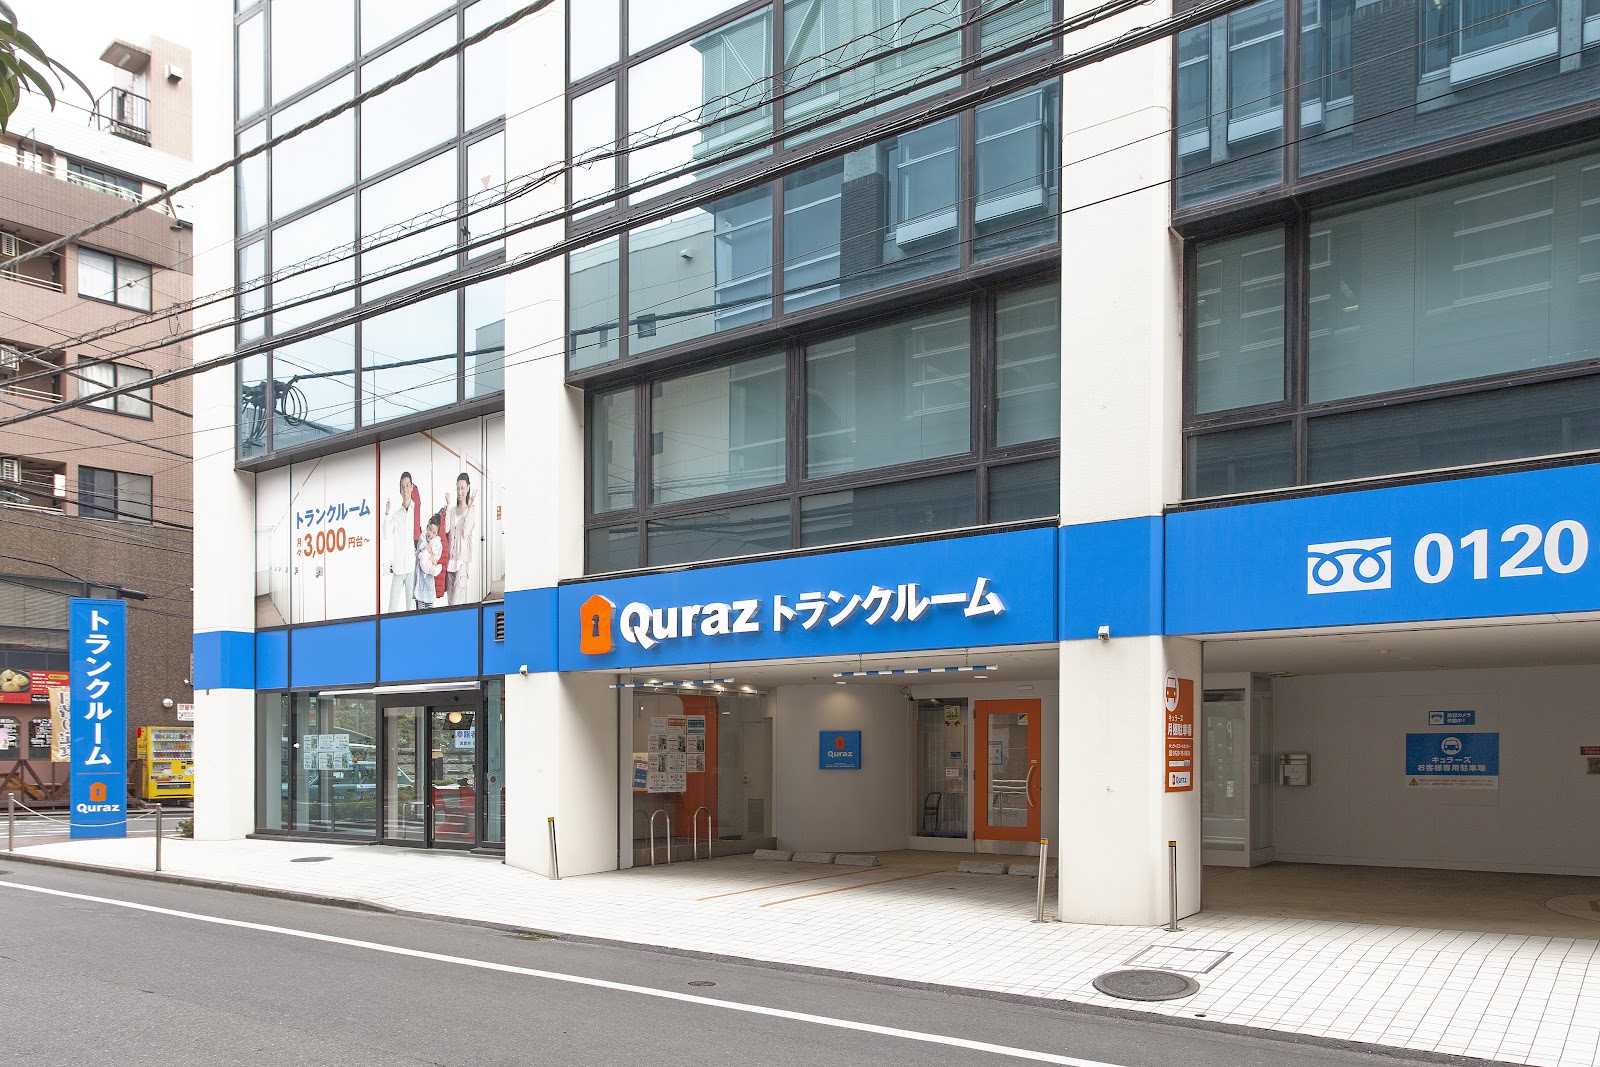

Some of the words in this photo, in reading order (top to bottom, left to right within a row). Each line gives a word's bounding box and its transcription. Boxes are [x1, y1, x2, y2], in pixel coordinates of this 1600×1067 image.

[297, 498, 371, 530] トランクルーム
[1413, 519, 1589, 584] 0120
[620, 599, 761, 649] Quraz
[773, 577, 1006, 632] トランクルーム
[84, 610, 112, 765] トランクルーム
[827, 750, 853, 758] Quraz
[1417, 764, 1486, 772] お客様専用駐車場
[76, 803, 120, 815] Quraz
